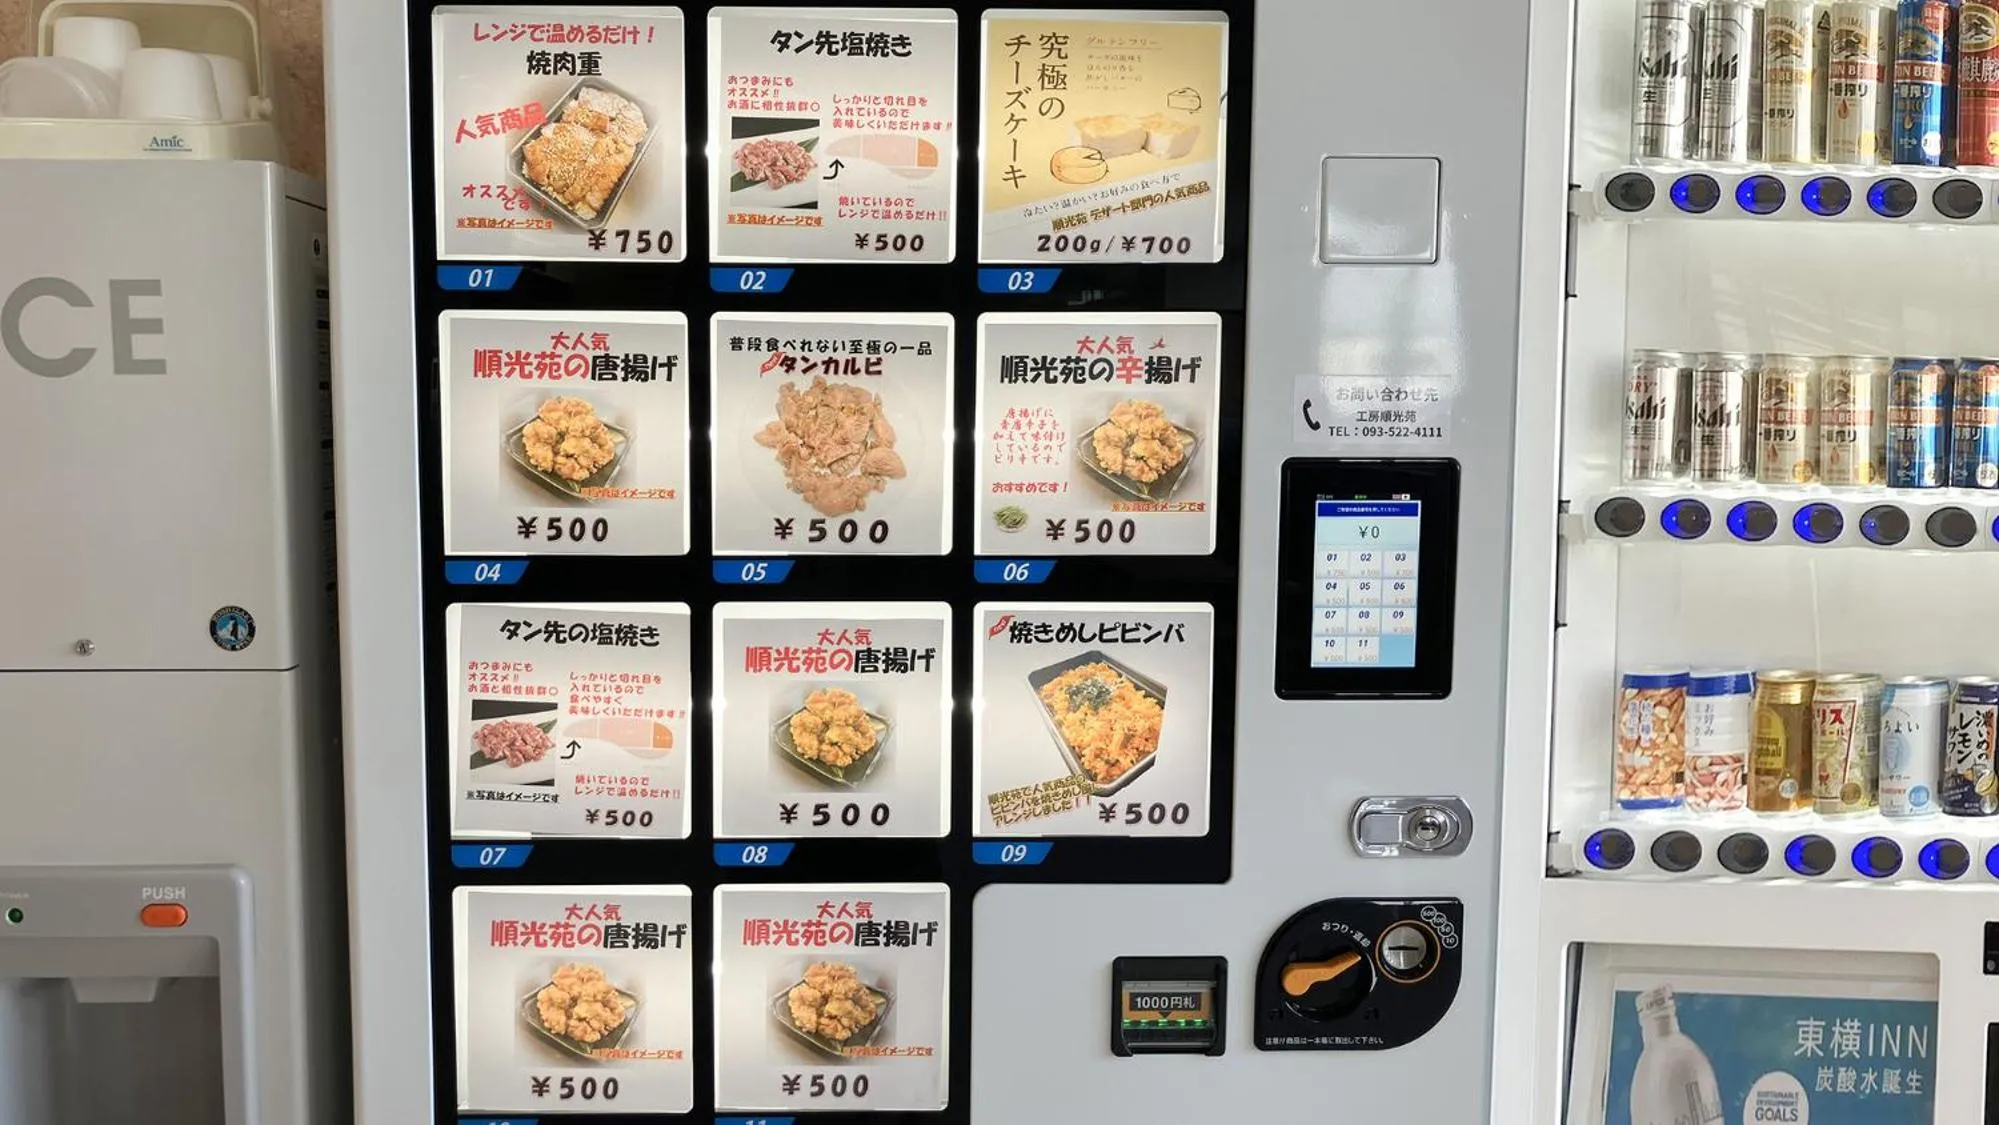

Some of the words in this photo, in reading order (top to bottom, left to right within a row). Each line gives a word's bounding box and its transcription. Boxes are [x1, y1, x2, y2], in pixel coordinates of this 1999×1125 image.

[473, 23, 655, 44] レンジで温めるだけ!
[770, 30, 912, 58] タン先塩焼き
[526, 50, 602, 76] 焼肉重
[727, 75, 794, 87] おつまみにも
[1037, 31, 1069, 120] 究極の
[727, 88, 779, 98] オススメ!!
[832, 94, 927, 107] しっかりと切れ目を
[832, 106, 909, 118] 入れているので
[1002, 34, 1031, 189] チーズケーキ
[455, 101, 548, 144] 人気商品
[150, 136, 184, 148] Amic
[462, 184, 526, 198] オススメ
[839, 196, 915, 208] 焼いているので
[1052, 212, 1087, 232] 順光苑
[1090, 180, 1210, 223] デザート部門の人気商品
[456, 216, 553, 229] ※写真はイメージです
[728, 214, 823, 227] ※写真はイメージです
[838, 208, 947, 221] レンジで温めるだけ!!
[588, 229, 673, 254] ¥750
[855, 232, 924, 252] ¥500
[469, 268, 493, 288] 01
[739, 271, 767, 290] 02
[1008, 271, 1034, 291] 03
[551, 332, 610, 351] 大人気
[729, 337, 932, 356] 普段食べれない至極の一品
[1077, 336, 1135, 355] 大人気
[473, 349, 677, 382] 順光苑の唐揚げ
[779, 356, 883, 376] タンカルビ
[1000, 355, 1202, 384] 順光苑の辛揚げ
[1336, 387, 1439, 402] お問い合わせ先
[1006, 408, 1054, 418] 唐揚げに
[1356, 410, 1417, 422] 工房順光苑
[1000, 419, 1059, 430] 青唐辛子を
[993, 431, 1065, 441] 加えて味付け
[996, 443, 1065, 452] しているので
[992, 482, 1068, 493] おすすめです!
[517, 516, 608, 541] ¥500
[1046, 518, 1135, 543] ¥500
[1359, 526, 1380, 539] ¥0
[1327, 553, 1337, 561] 01
[1360, 553, 1372, 561] 02
[1395, 553, 1406, 561] 03
[475, 563, 500, 582] 04
[741, 562, 767, 582] 05
[1004, 563, 1029, 581] 06
[1326, 582, 1337, 590] 04
[1360, 582, 1370, 590] 05
[1394, 582, 1405, 590] 06
[1325, 611, 1336, 619] 07
[1359, 611, 1370, 619] 08
[1393, 611, 1404, 619] 09
[500, 619, 660, 647] タン先の塩焼き
[818, 628, 872, 646] 大人気
[1009, 622, 1185, 644] 焼きめしピビンバ
[468, 661, 533, 672] おつまみにも
[745, 646, 936, 674] 順光苑の唐揚げ
[570, 672, 662, 684] しっかりと切れ目を
[570, 684, 644, 695] 入れているので
[570, 695, 623, 705] 食べやすく
[1816, 708, 1844, 725] リス
[1957, 712, 1976, 764] レモン
[575, 775, 649, 786] 焼いているので
[466, 790, 559, 803] ※写真はイメージです
[575, 787, 680, 799] レンジで温めるだけ!!
[586, 809, 653, 827] ¥500
[1099, 803, 1190, 825] ¥500
[480, 847, 506, 865] 07
[742, 846, 768, 864] 08
[1001, 845, 1026, 863] 09
[142, 887, 186, 899] PUSH
[565, 904, 622, 921] 大人気
[817, 901, 873, 919] 大人気
[491, 920, 687, 949] 順光苑の唐揚げ
[743, 919, 938, 947] 順光苑の唐揚げ
[1136, 996, 1196, 1009] 1000円札
[1793, 1017, 1928, 1059] 東横INN
[531, 1076, 619, 1100] ¥500
[782, 1074, 869, 1097] ¥500
[1815, 1066, 1923, 1094] 炭酸水誕生
[1755, 1107, 1798, 1121] GOALS
